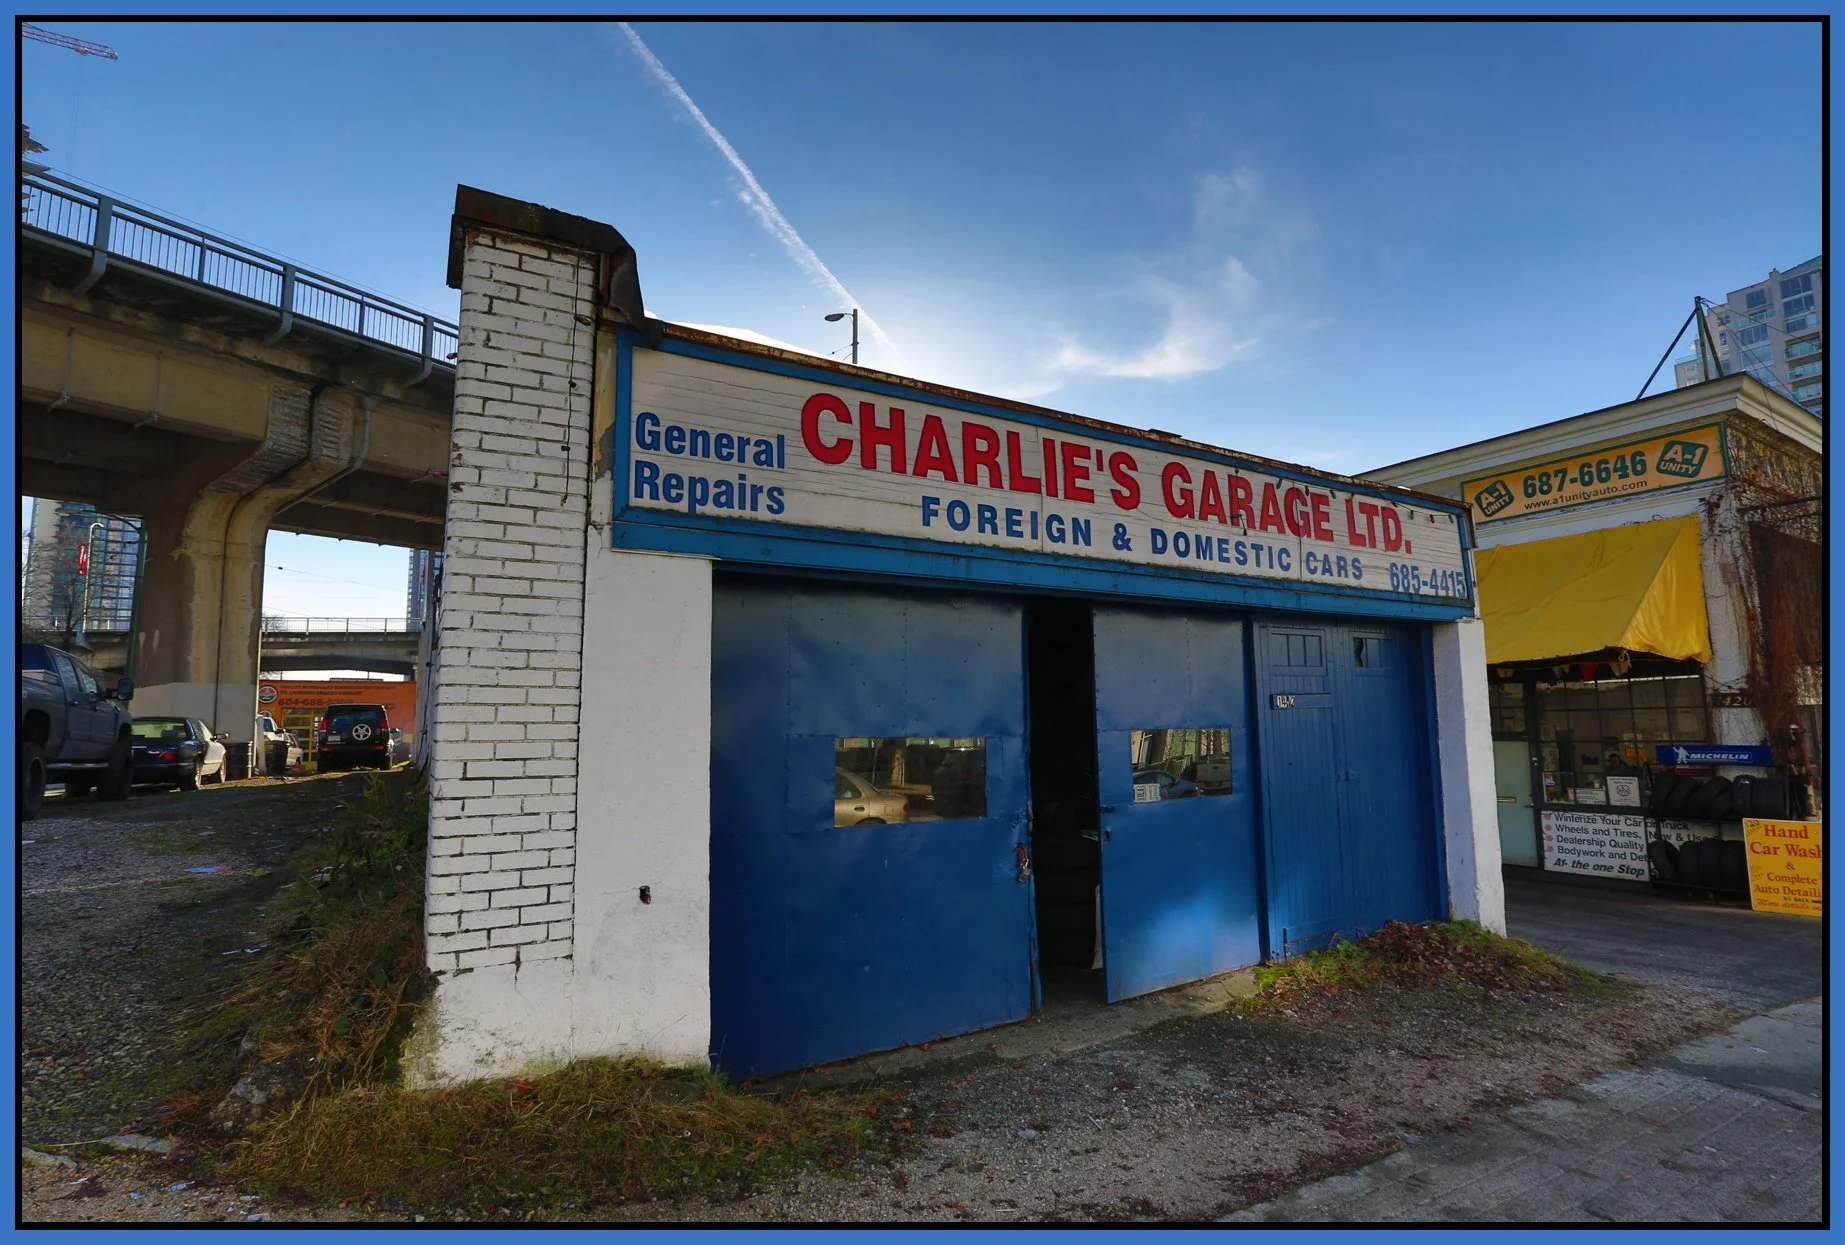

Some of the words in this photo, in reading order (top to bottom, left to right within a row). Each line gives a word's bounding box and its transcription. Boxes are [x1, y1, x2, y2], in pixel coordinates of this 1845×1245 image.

[636, 412, 785, 469] General
[801, 393, 1141, 510] CHARLIE'S
[1162, 462, 1334, 542] GARAGE
[1345, 498, 1412, 554] LTD.
[1523, 450, 1647, 499] 687-6646
[1660, 461, 1697, 474] UNITY
[634, 460, 785, 515] Repairs
[1524, 480, 1648, 510] www.a1unityauto.com
[1485, 495, 1510, 514] UNITY
[922, 495, 1091, 547] FOREIGN
[1113, 523, 1132, 551] &
[1151, 528, 1292, 573] DOMESTIC
[1306, 554, 1363, 580] CARS
[1390, 562, 1467, 599] 685-4415
[1554, 813, 1597, 825] Winterize
[1600, 815, 1621, 826] Your
[1624, 817, 1642, 828] Car
[1556, 824, 1589, 835] Wheels
[1592, 828, 1609, 837] and
[1612, 829, 1642, 839] Tires,
[1764, 824, 1810, 839] Hand
[1557, 835, 1606, 848] Dealership
[1609, 840, 1645, 852] Quality
[1750, 841, 1780, 855] Car
[1784, 843, 1822, 858] Wash
[1557, 846, 1605, 858] Bodywork
[1608, 852, 1627, 861] and
[1571, 860, 1589, 870] the
[1593, 863, 1614, 873] one
[1618, 864, 1645, 878] Stop
[1786, 861, 1795, 870] &
[1767, 872, 1818, 885] Complete
[1754, 884, 1780, 894] Auto
